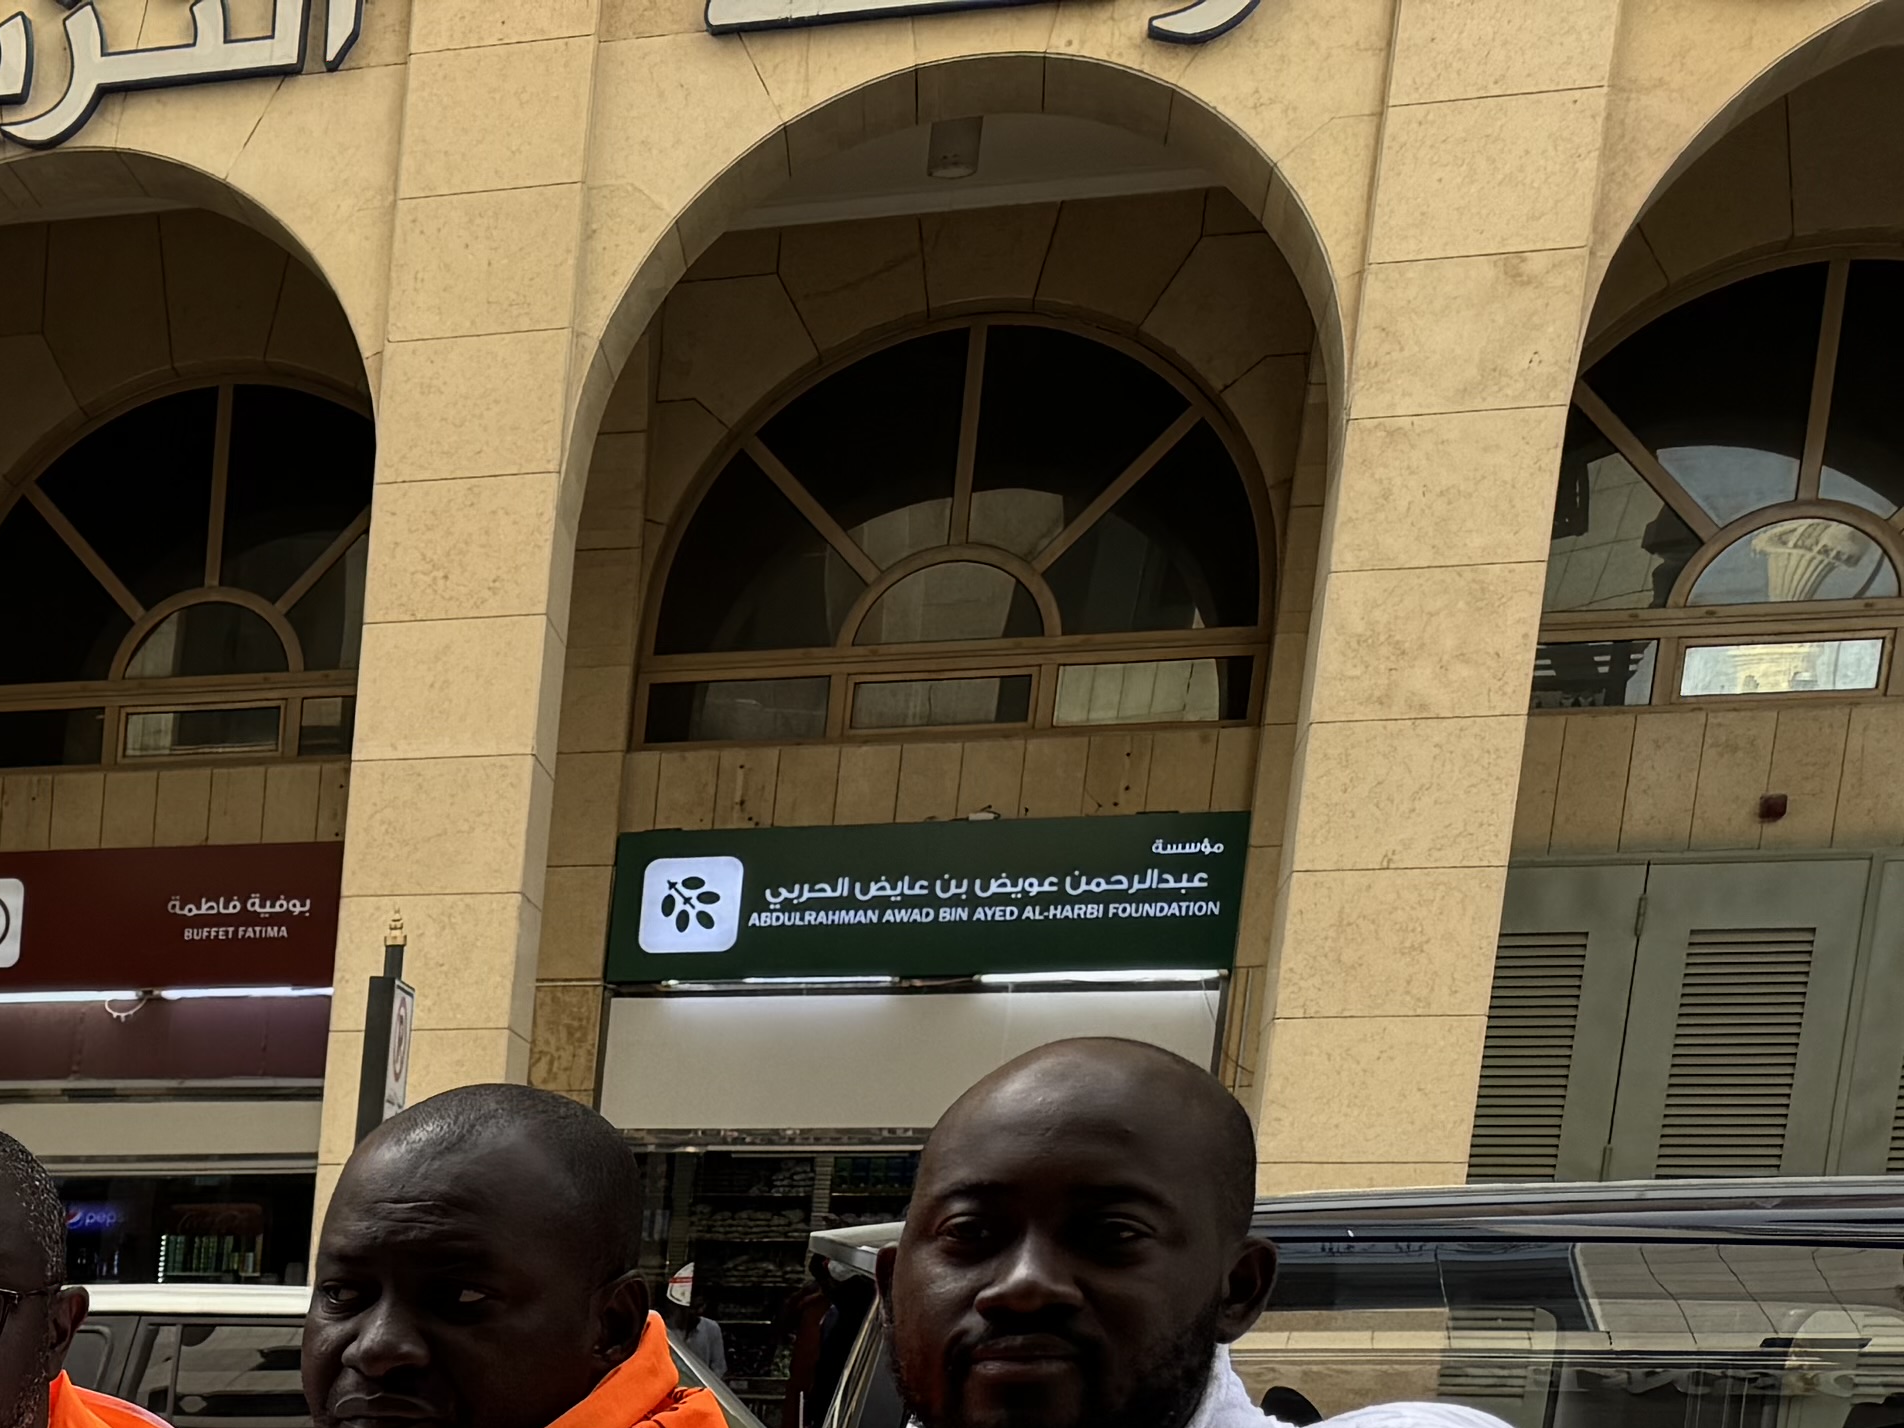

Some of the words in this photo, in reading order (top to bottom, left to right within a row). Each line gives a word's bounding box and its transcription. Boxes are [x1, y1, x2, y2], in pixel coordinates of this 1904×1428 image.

[1152, 838, 1224, 856] مؤسسة
[764, 876, 850, 910] الحربي
[854, 875, 929, 901] عايض
[935, 874, 969, 900] بن
[974, 872, 1059, 899] عويض
[1065, 868, 1209, 895] عبدالرحمن
[167, 896, 241, 917] فاطمة
[247, 893, 311, 917] بوفية
[748, 909, 880, 927] ABDULRAHMAN
[882, 907, 935, 923] AWAD
[938, 907, 969, 922] BIN
[972, 905, 1018, 921] AYED
[1021, 903, 1104, 920] AL-HARBI
[1108, 901, 1220, 918] FOUNDATION
[184, 927, 235, 940] BUFFET
[238, 926, 289, 939] FATIMA
